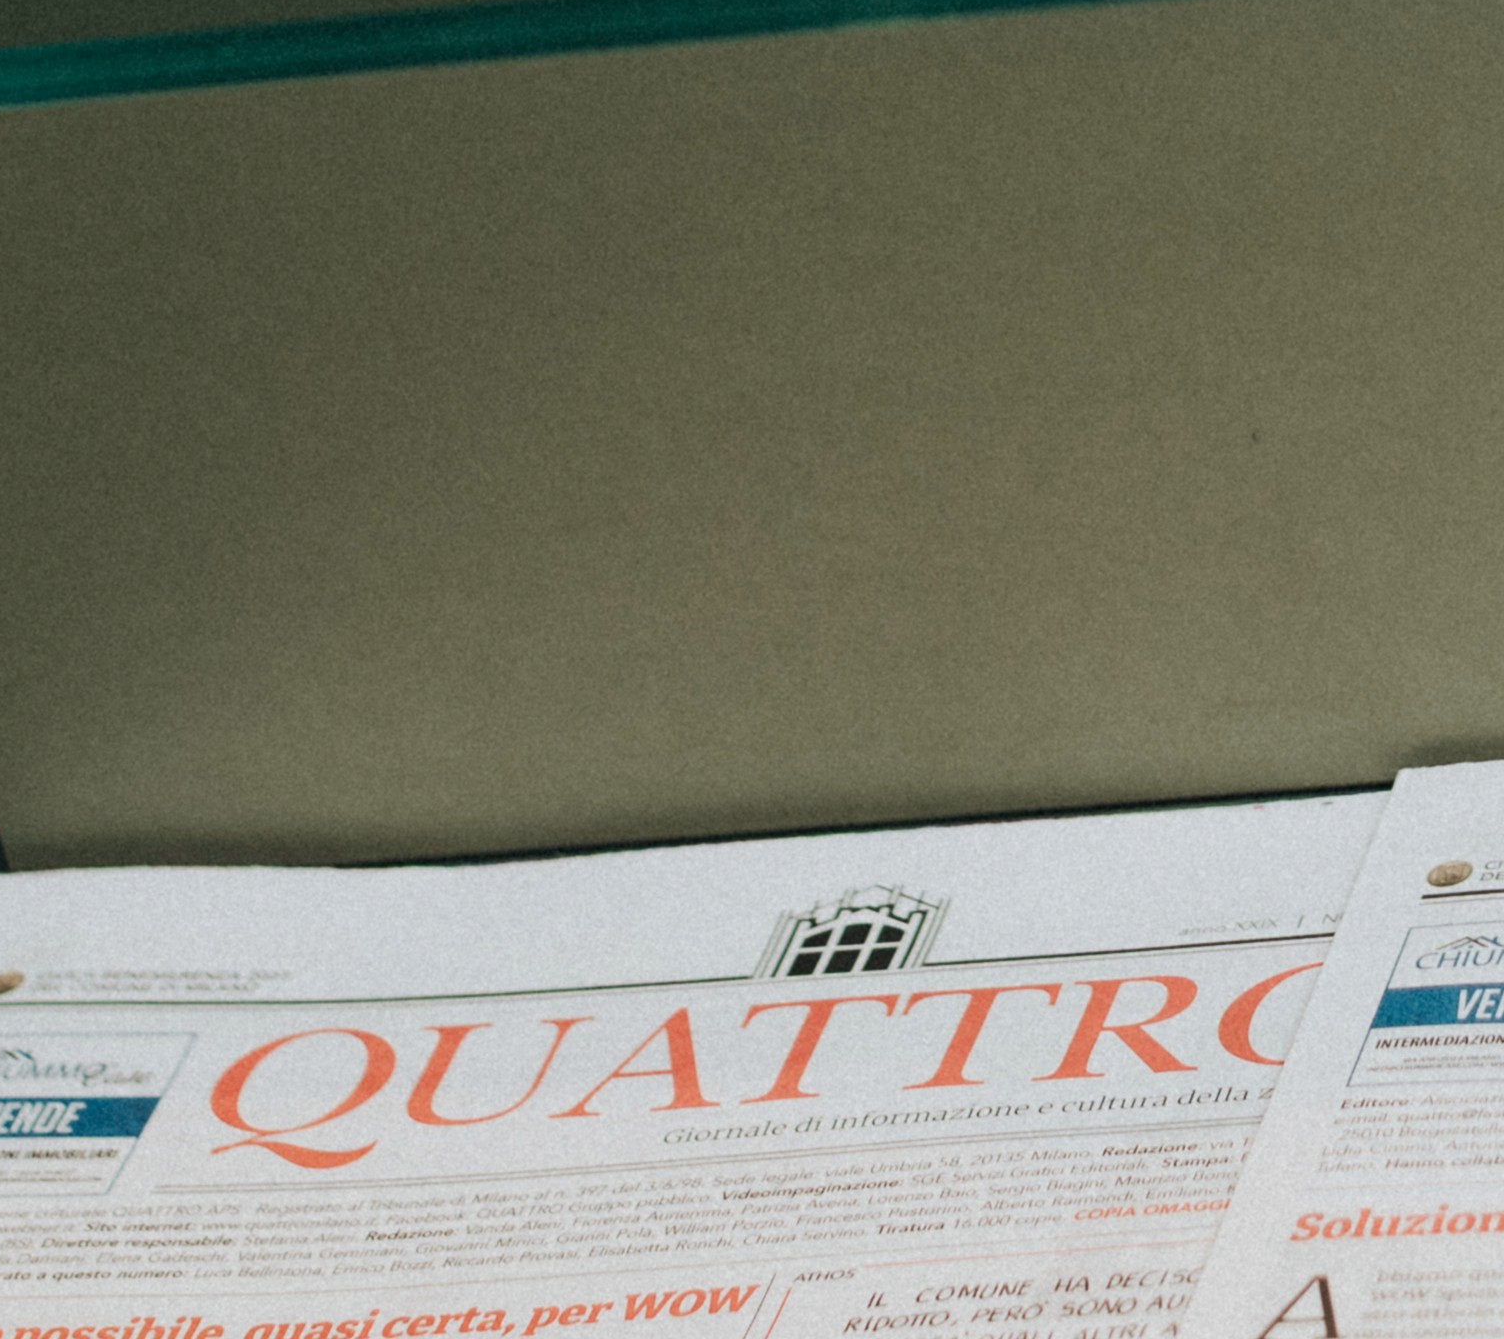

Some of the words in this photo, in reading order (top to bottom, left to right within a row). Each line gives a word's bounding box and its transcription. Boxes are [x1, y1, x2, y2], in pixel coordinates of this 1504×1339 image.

[662, 1119, 788, 1145] Giornale
[794, 1116, 822, 1134] di
[830, 1104, 1030, 1132] informazione
[1037, 1102, 1055, 1117] e
[1061, 1094, 1169, 1114] cultura
[1177, 1086, 1249, 1106] della
[475, 1203, 565, 1219] QUATTRO
[1010, 1164, 1066, 1180] Grafici
[869, 1160, 934, 1176] Umbria
[40, 1235, 120, 1250] Direttore
[740, 1202, 802, 1217] Patrizia
[867, 1191, 935, 1206] Lorenzo
[987, 1182, 1042, 1198] Sergio
[1114, 1171, 1189, 1187] Maurizio
[415, 1239, 493, 1255] Giovanni
[664, 1222, 728, 1237] William
[795, 1210, 883, 1227] Francesco
[981, 1196, 1046, 1213] Alberto
[35, 1270, 47, 1281] a
[51, 1269, 112, 1284] questo
[115, 1267, 188, 1281] numero:
[441, 1253, 515, 1270] Riccardo
[587, 1242, 672, 1259] Elisabetta
[742, 1232, 798, 1248] Chiara
[876, 1221, 945, 1237] Tiratura
[1073, 1206, 1138, 1222] COPIA
[792, 1268, 856, 1284] ATHOS
[866, 1290, 888, 1310] IL
[915, 1280, 1036, 1305] COMUNE
[1054, 1275, 1091, 1293] HA
[381, 1304, 516, 1339] certa,
[522, 1300, 616, 1339] per
[622, 1284, 762, 1322] WOW
[1058, 1295, 1139, 1319] SONO
